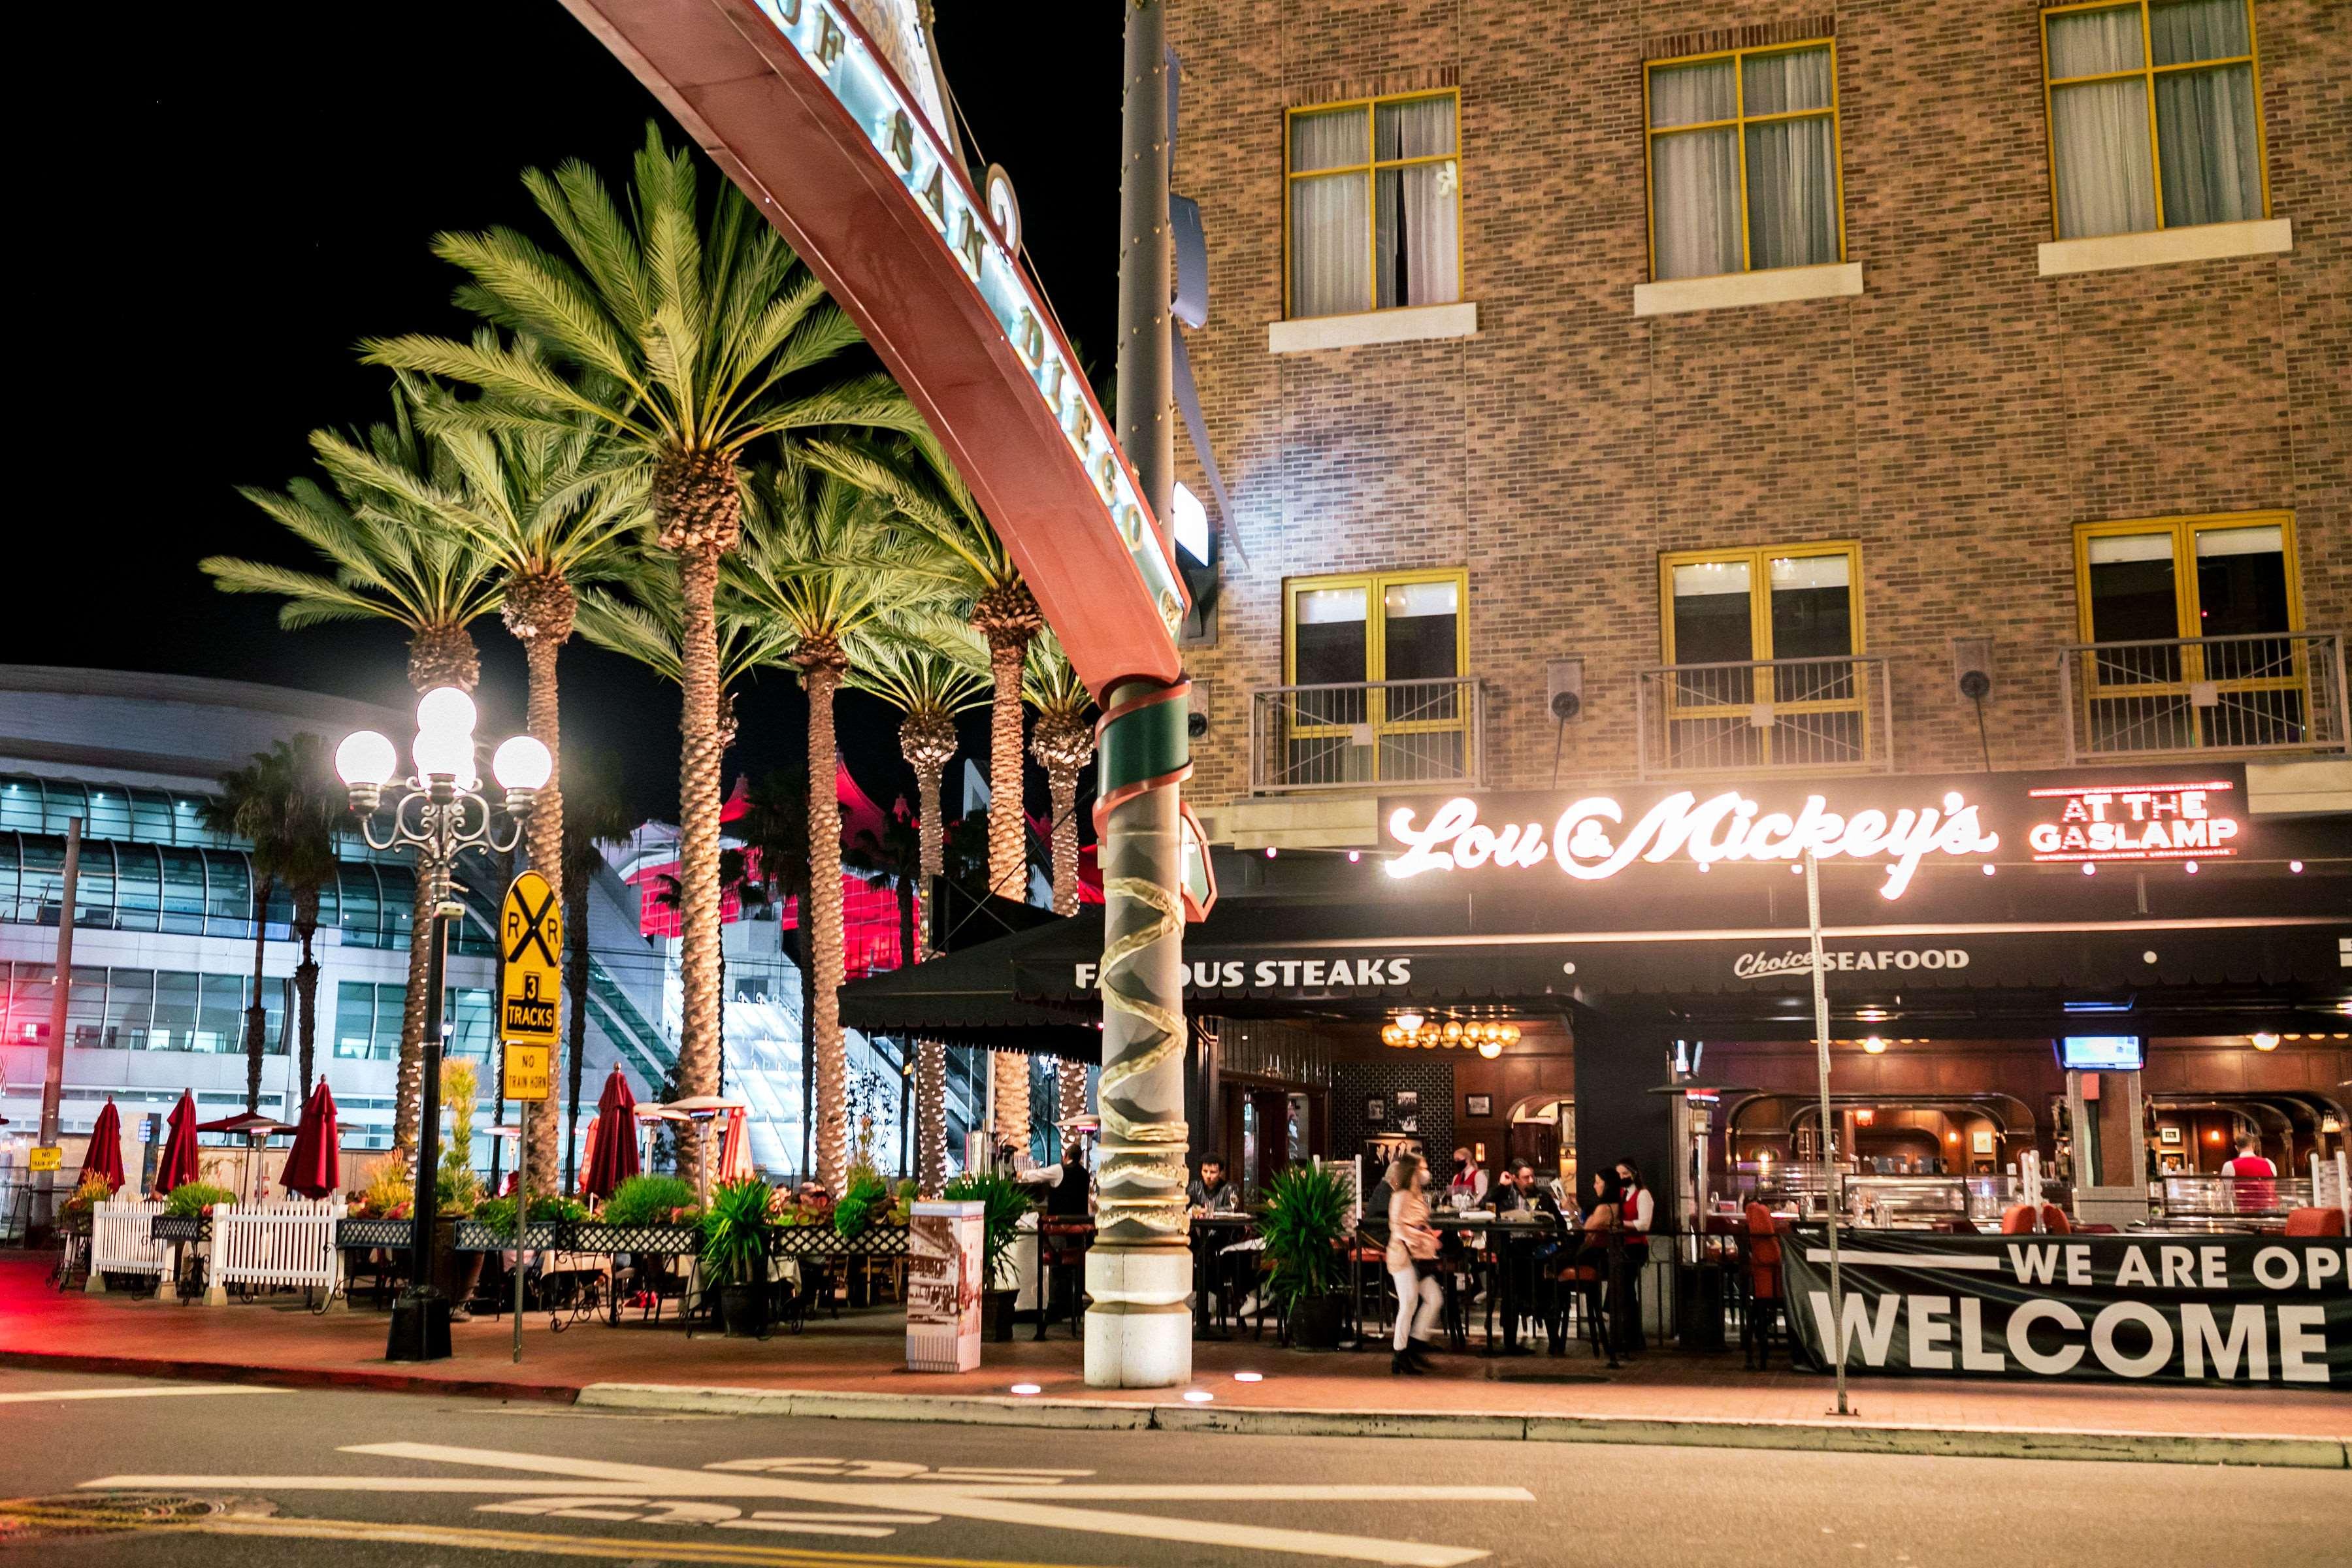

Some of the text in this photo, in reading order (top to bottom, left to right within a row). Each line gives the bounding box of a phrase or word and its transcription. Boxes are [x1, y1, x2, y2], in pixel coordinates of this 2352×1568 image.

[882, 106, 988, 283] SAN
[1014, 305, 1143, 552] DIEGO
[2062, 791, 2208, 823] AT THE
[1384, 796, 1547, 879] Lou
[1620, 791, 1999, 900] Mickey's
[2029, 819, 2238, 852] GASLAMP
[1075, 958, 1411, 988] FUS STEAKS
[1734, 949, 1970, 978] Choice SEAFOOD
[527, 977, 536, 1000] 3
[508, 1005, 553, 1028] TRACKS
[522, 1055, 534, 1068] NO
[509, 1075, 546, 1089] TRAIN HORN
[2007, 1243, 2092, 1286] WE
[2116, 1245, 2229, 1288] ARE
[1809, 1290, 2330, 1383] WELCOME
